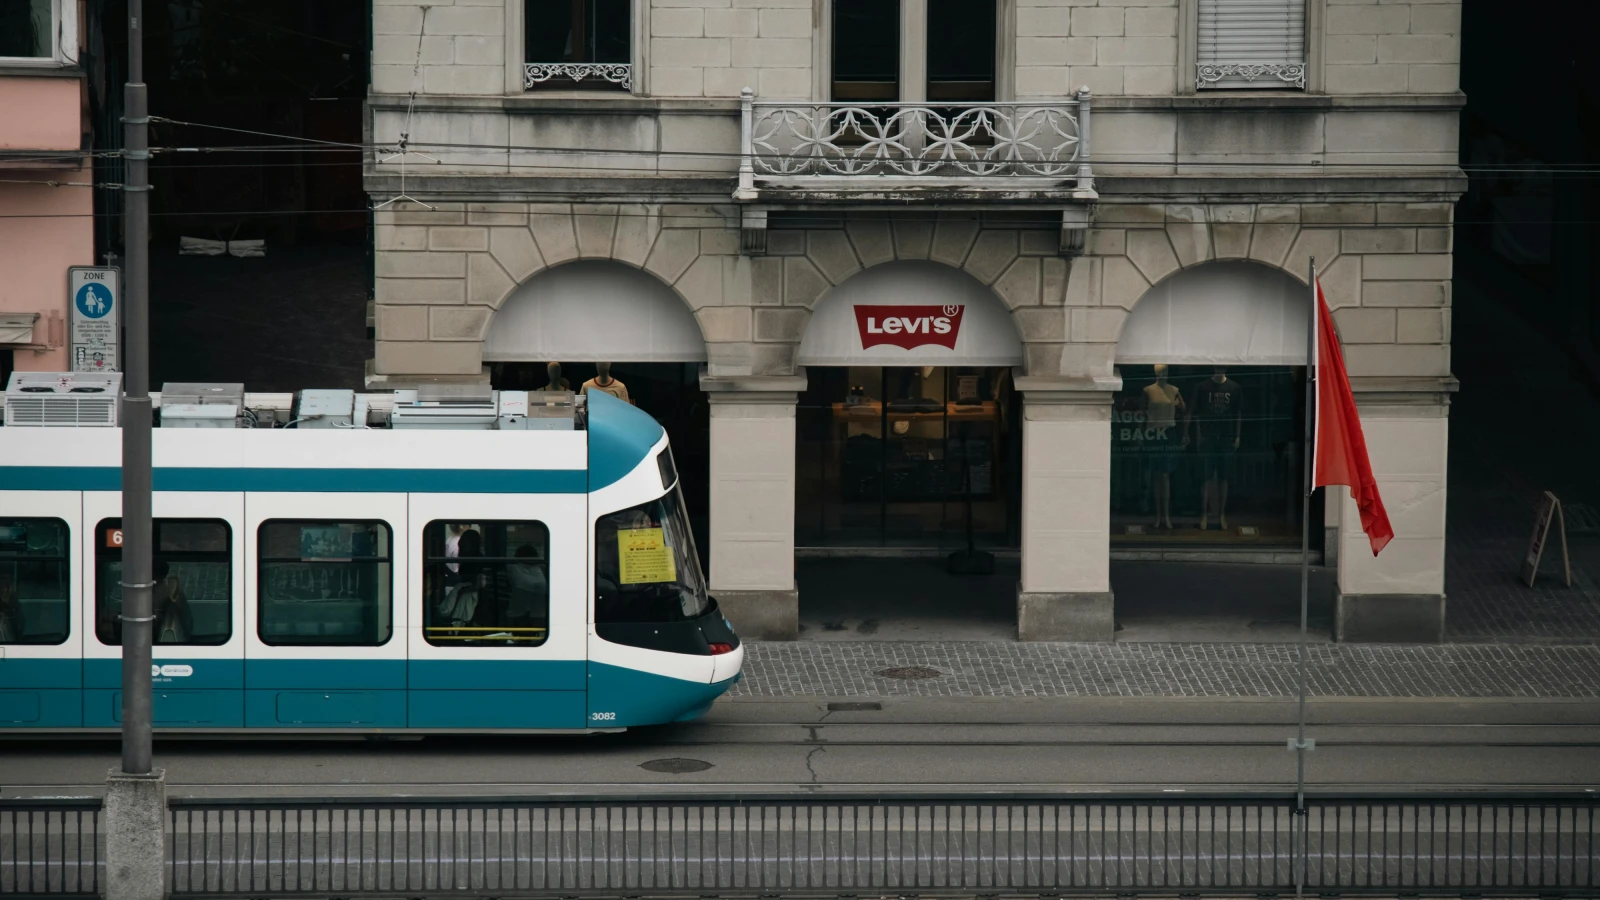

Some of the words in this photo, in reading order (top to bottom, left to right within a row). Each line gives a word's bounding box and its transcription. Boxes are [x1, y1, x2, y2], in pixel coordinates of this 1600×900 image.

[1120, 428, 1168, 440] BACK
[112, 530, 123, 544] 6
[592, 712, 616, 720] 3082
